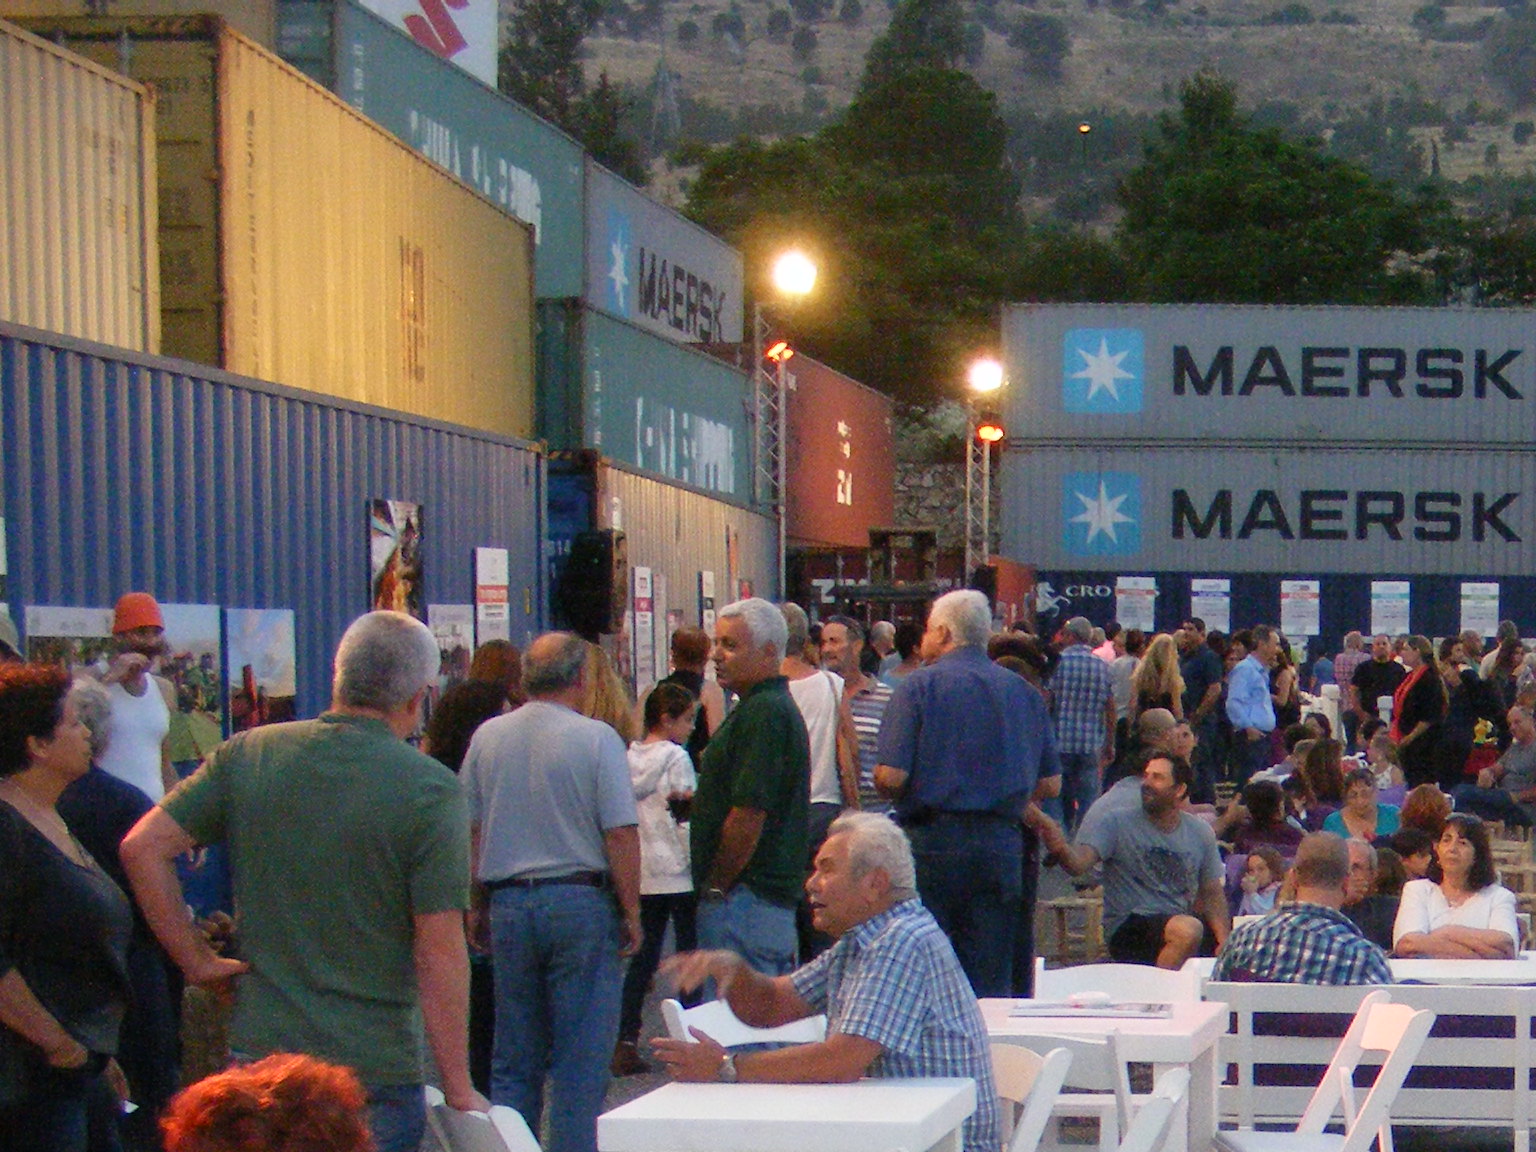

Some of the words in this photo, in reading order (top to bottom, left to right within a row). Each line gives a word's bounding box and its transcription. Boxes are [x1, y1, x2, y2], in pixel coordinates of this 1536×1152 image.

[639, 247, 726, 343] MAERSK
[1172, 345, 1524, 400] MAERSK
[1171, 489, 1522, 542] MAERSK
